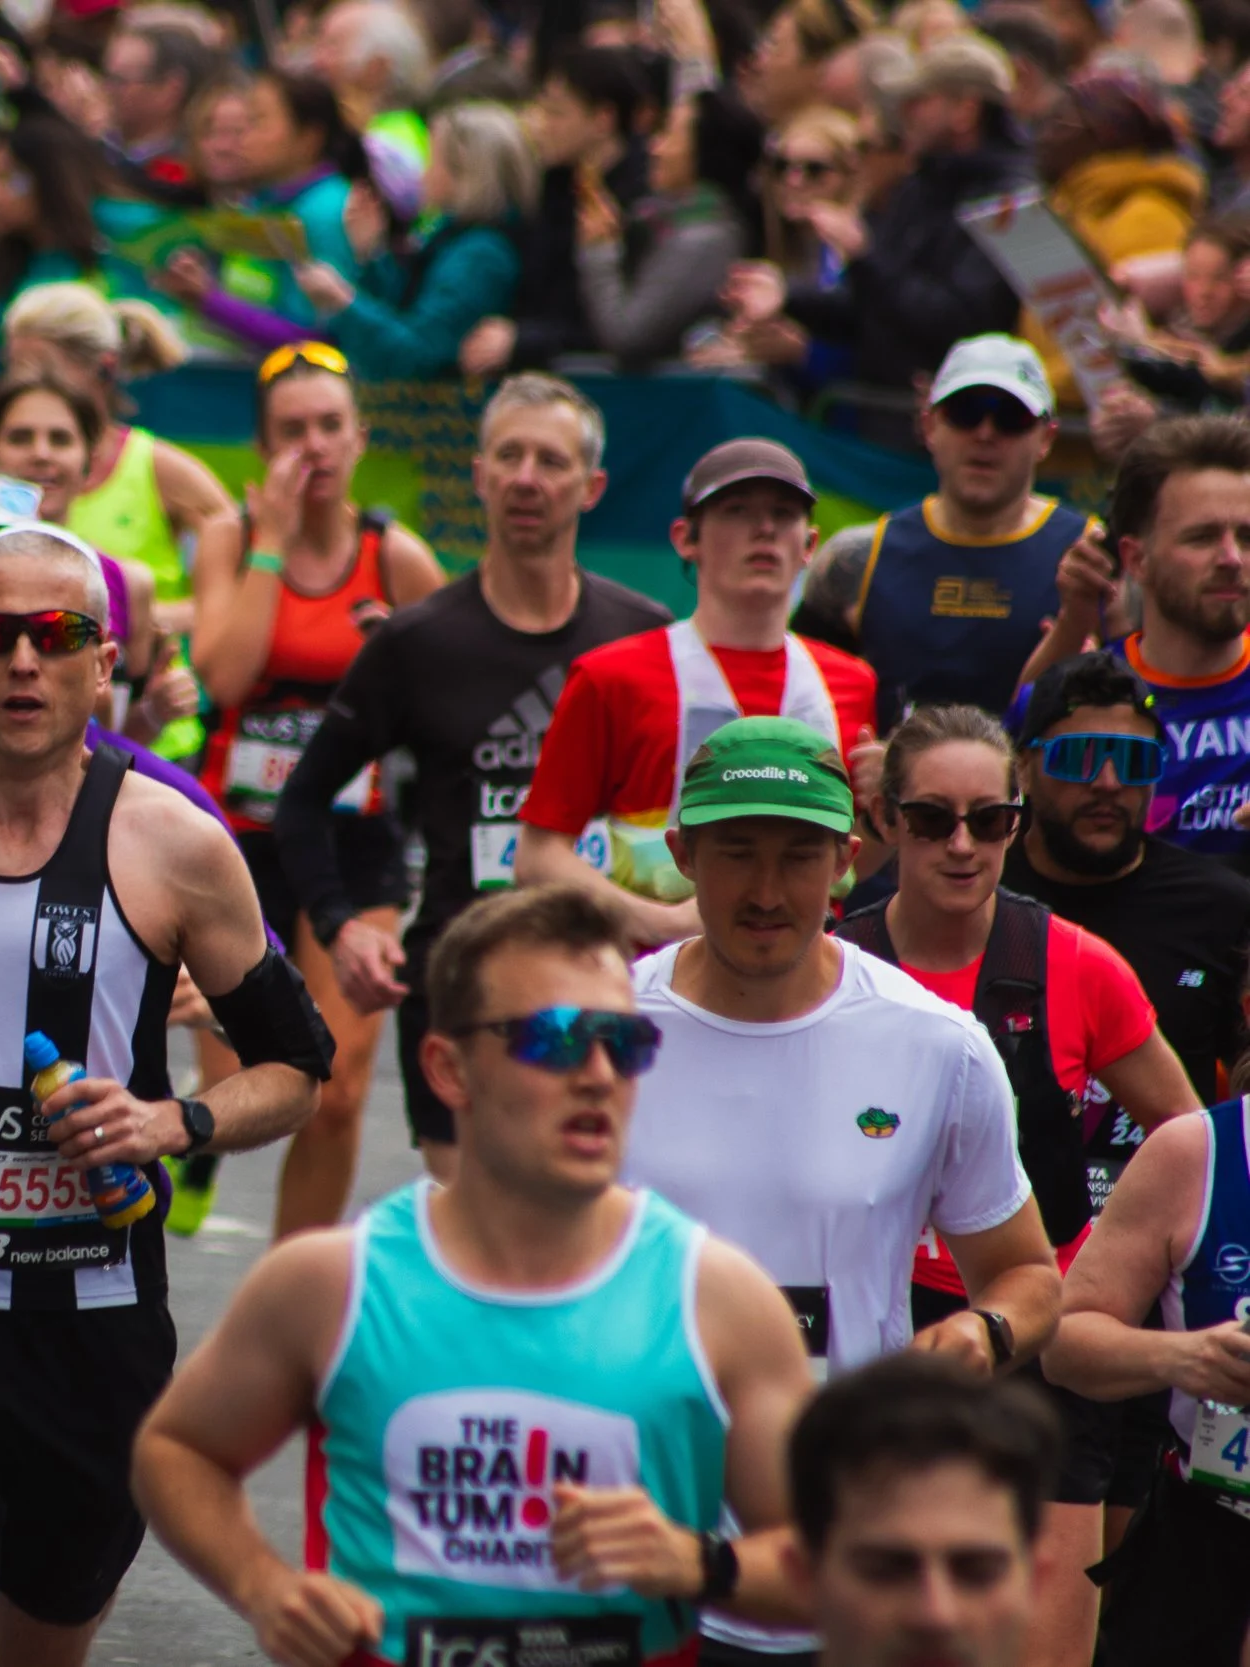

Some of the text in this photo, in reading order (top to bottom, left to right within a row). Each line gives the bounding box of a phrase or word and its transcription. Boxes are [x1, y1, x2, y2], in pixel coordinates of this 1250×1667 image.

[723, 767, 809, 783] Crocodile Pie
[11, 1246, 110, 1264] new balance
[461, 1418, 518, 1444] THE
